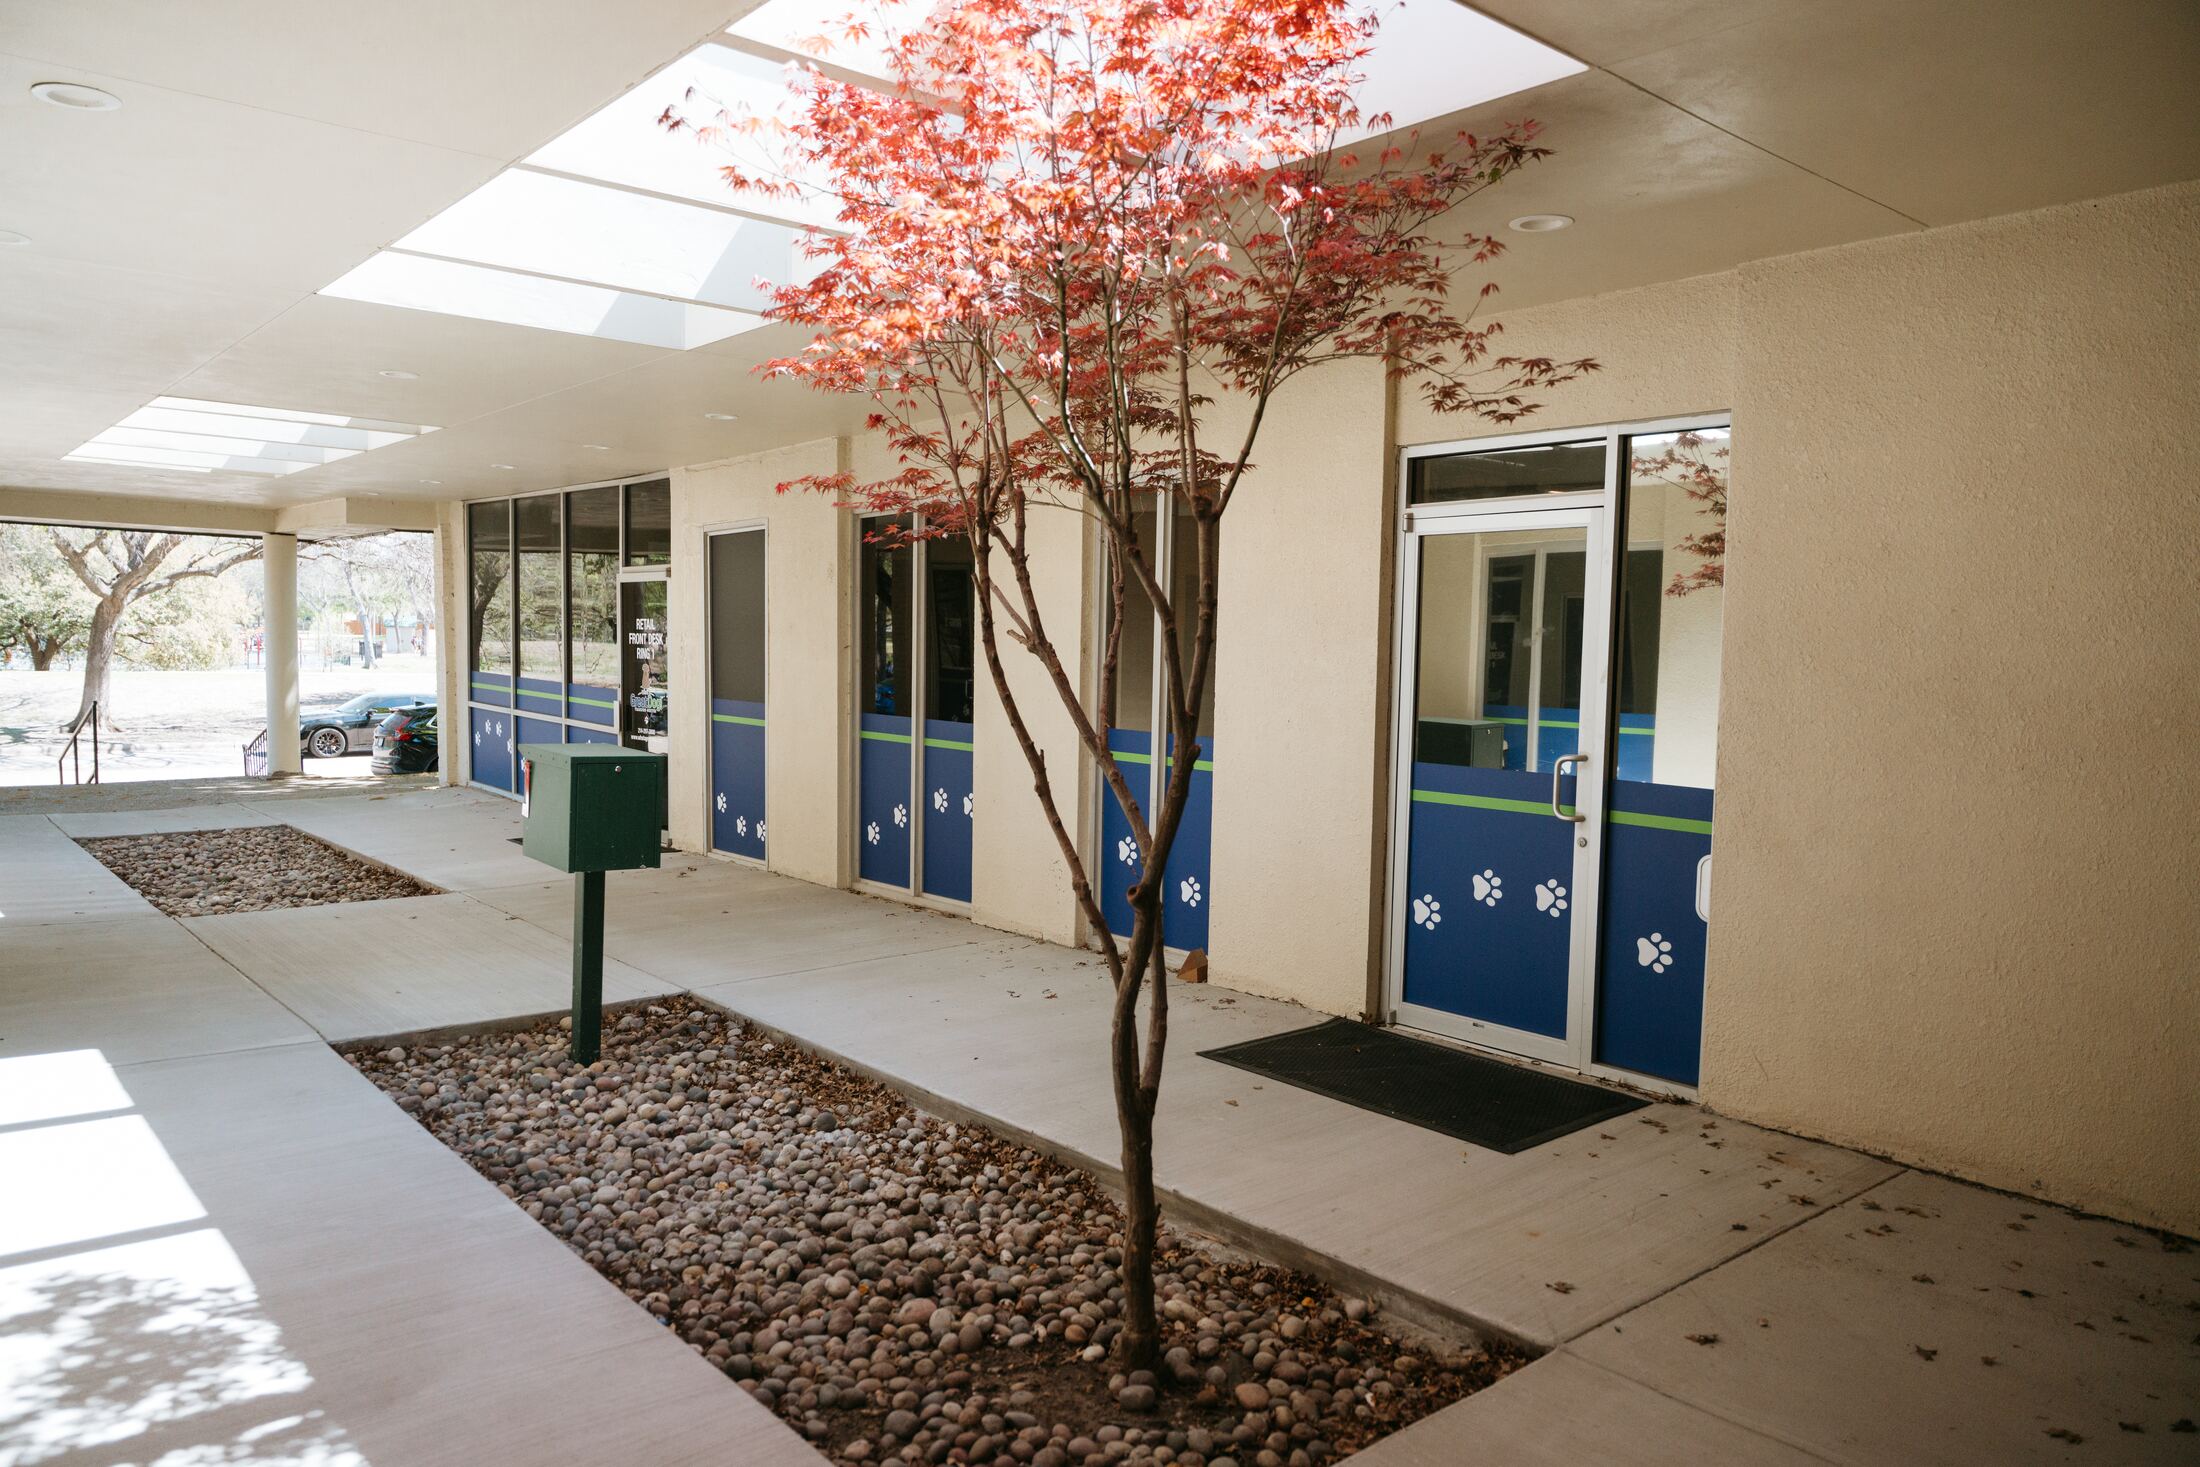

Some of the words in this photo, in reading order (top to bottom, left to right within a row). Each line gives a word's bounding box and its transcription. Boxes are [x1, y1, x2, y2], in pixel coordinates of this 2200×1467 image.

[636, 618, 655, 630] RETAIL
[629, 633, 647, 645] FRONT
[648, 633, 663, 645] DESK
[636, 648, 650, 659] RING
